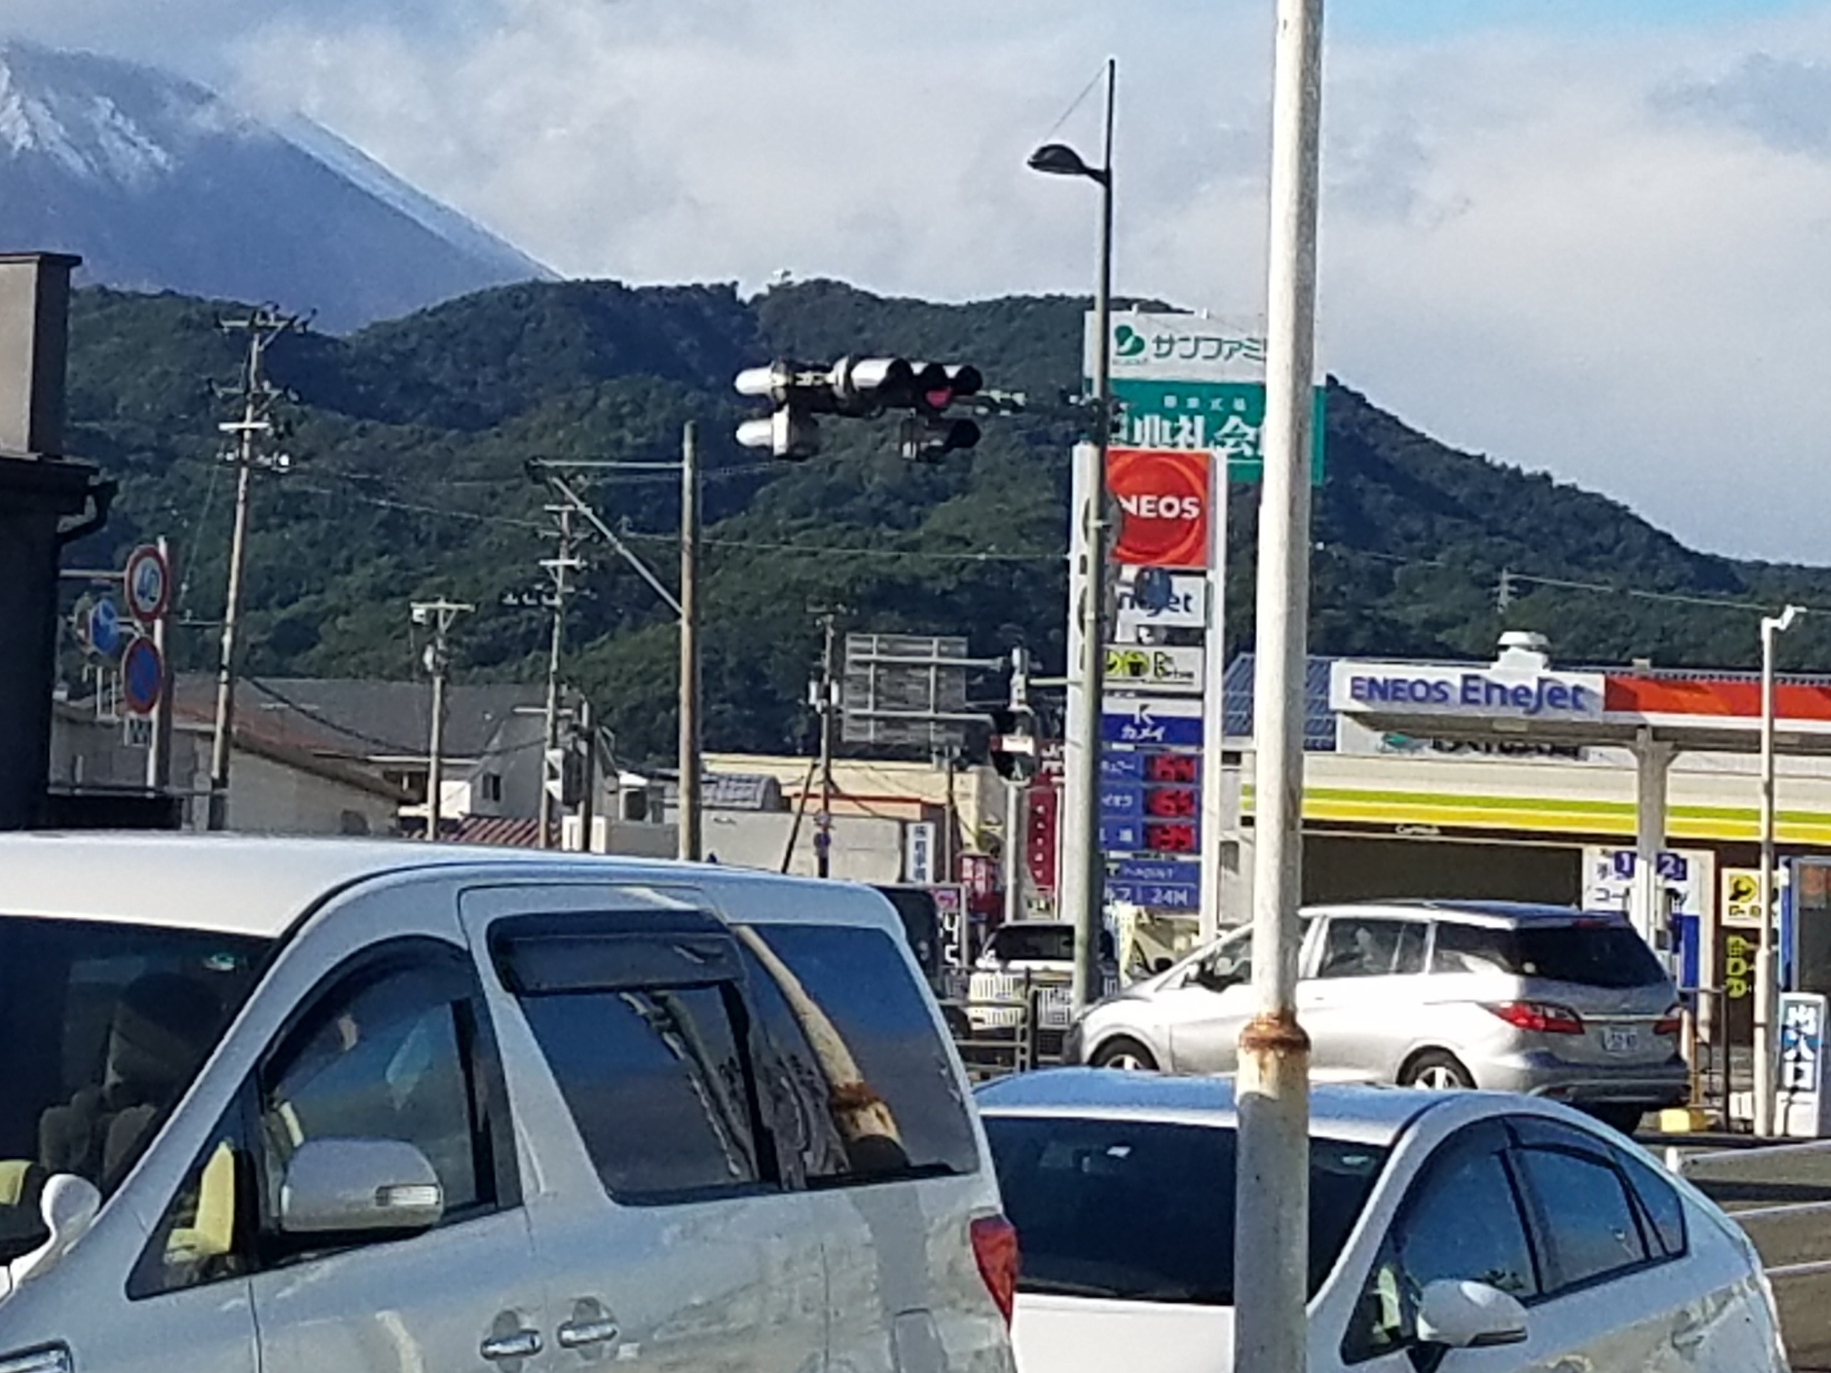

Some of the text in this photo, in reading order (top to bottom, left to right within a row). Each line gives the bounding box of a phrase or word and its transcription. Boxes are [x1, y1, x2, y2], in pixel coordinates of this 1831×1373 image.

[1350, 675, 1586, 715] ENEOS EneJet
[1121, 725, 1166, 741] カメイ
[1660, 855, 1675, 875] 2
